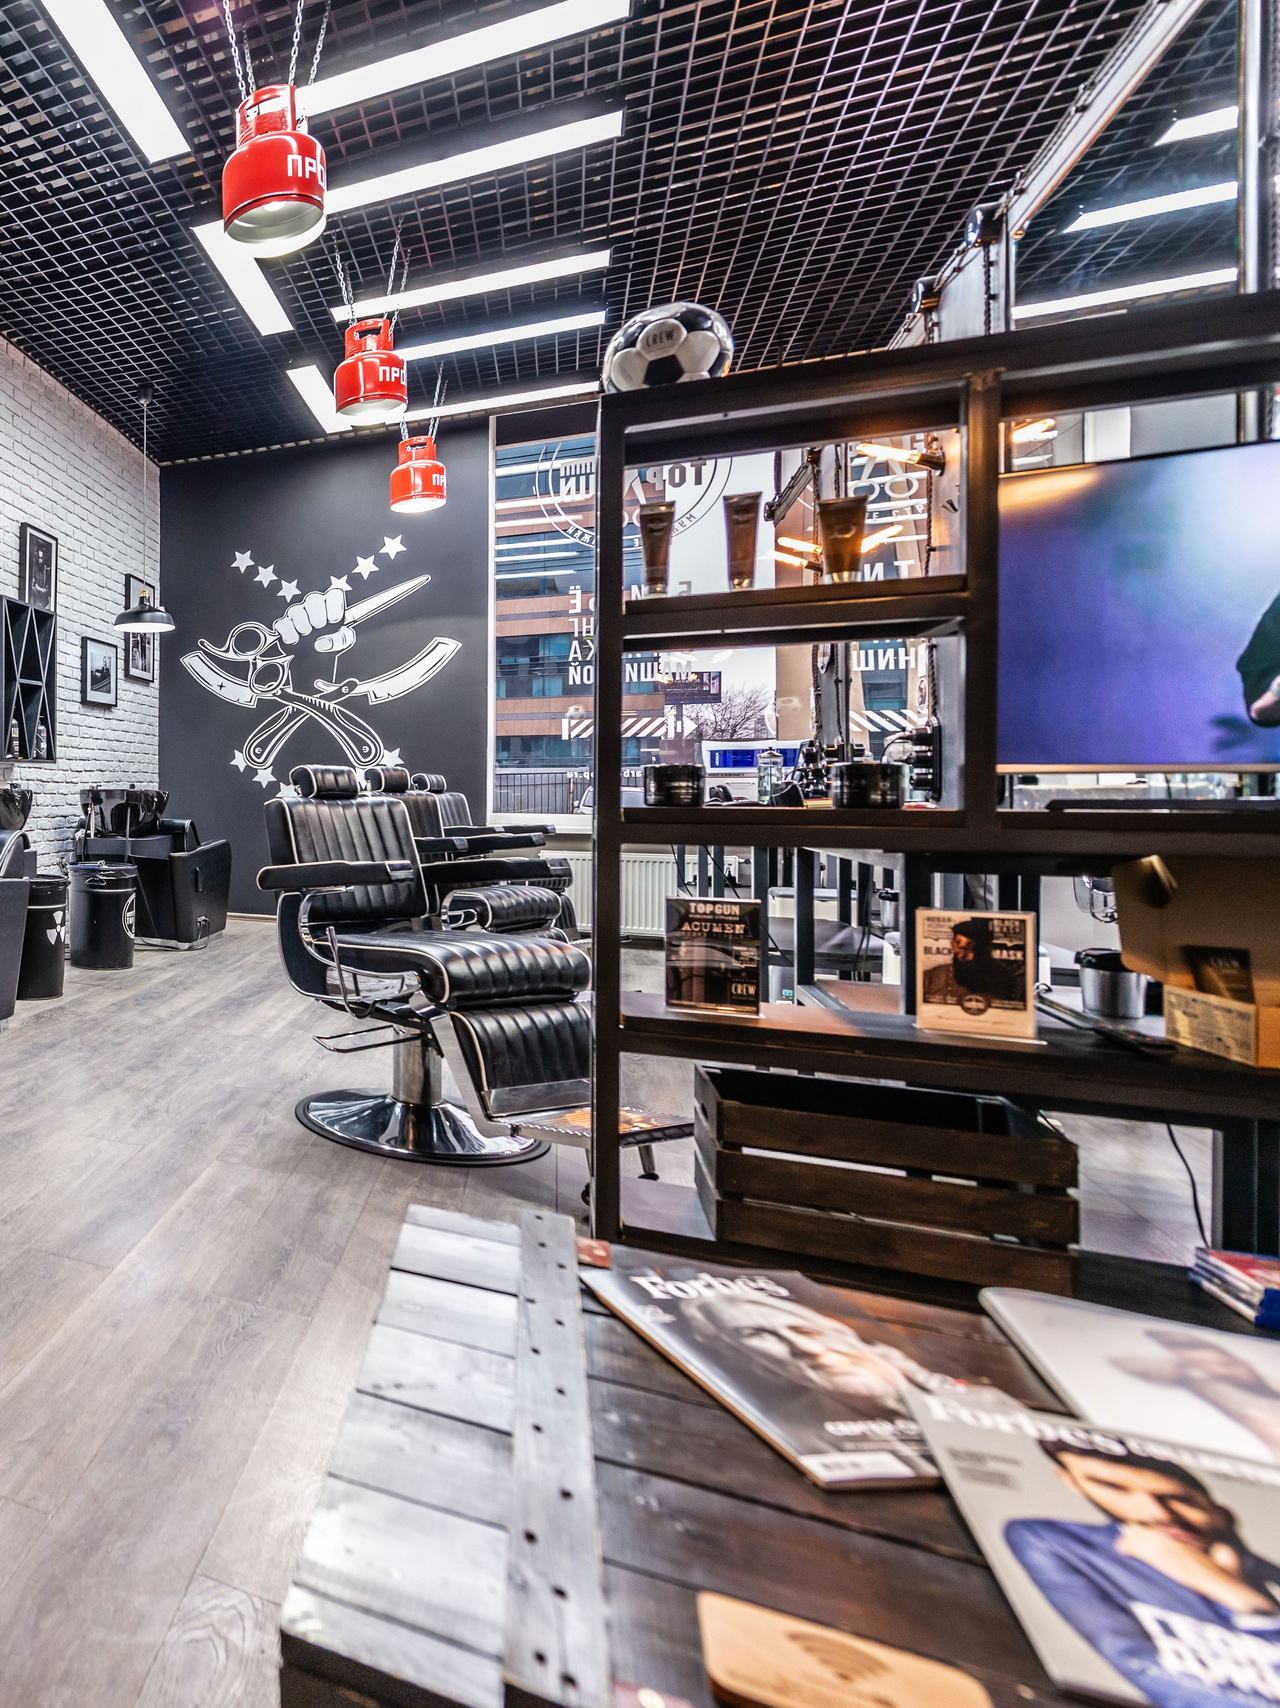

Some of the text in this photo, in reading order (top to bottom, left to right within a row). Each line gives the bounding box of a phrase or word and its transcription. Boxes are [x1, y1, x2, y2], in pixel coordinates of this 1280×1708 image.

[681, 920, 746, 935] ACUMEN
[731, 983, 757, 996] CREW
[629, 1271, 791, 1300] Forbes
[925, 1395, 1129, 1457] Forbes
